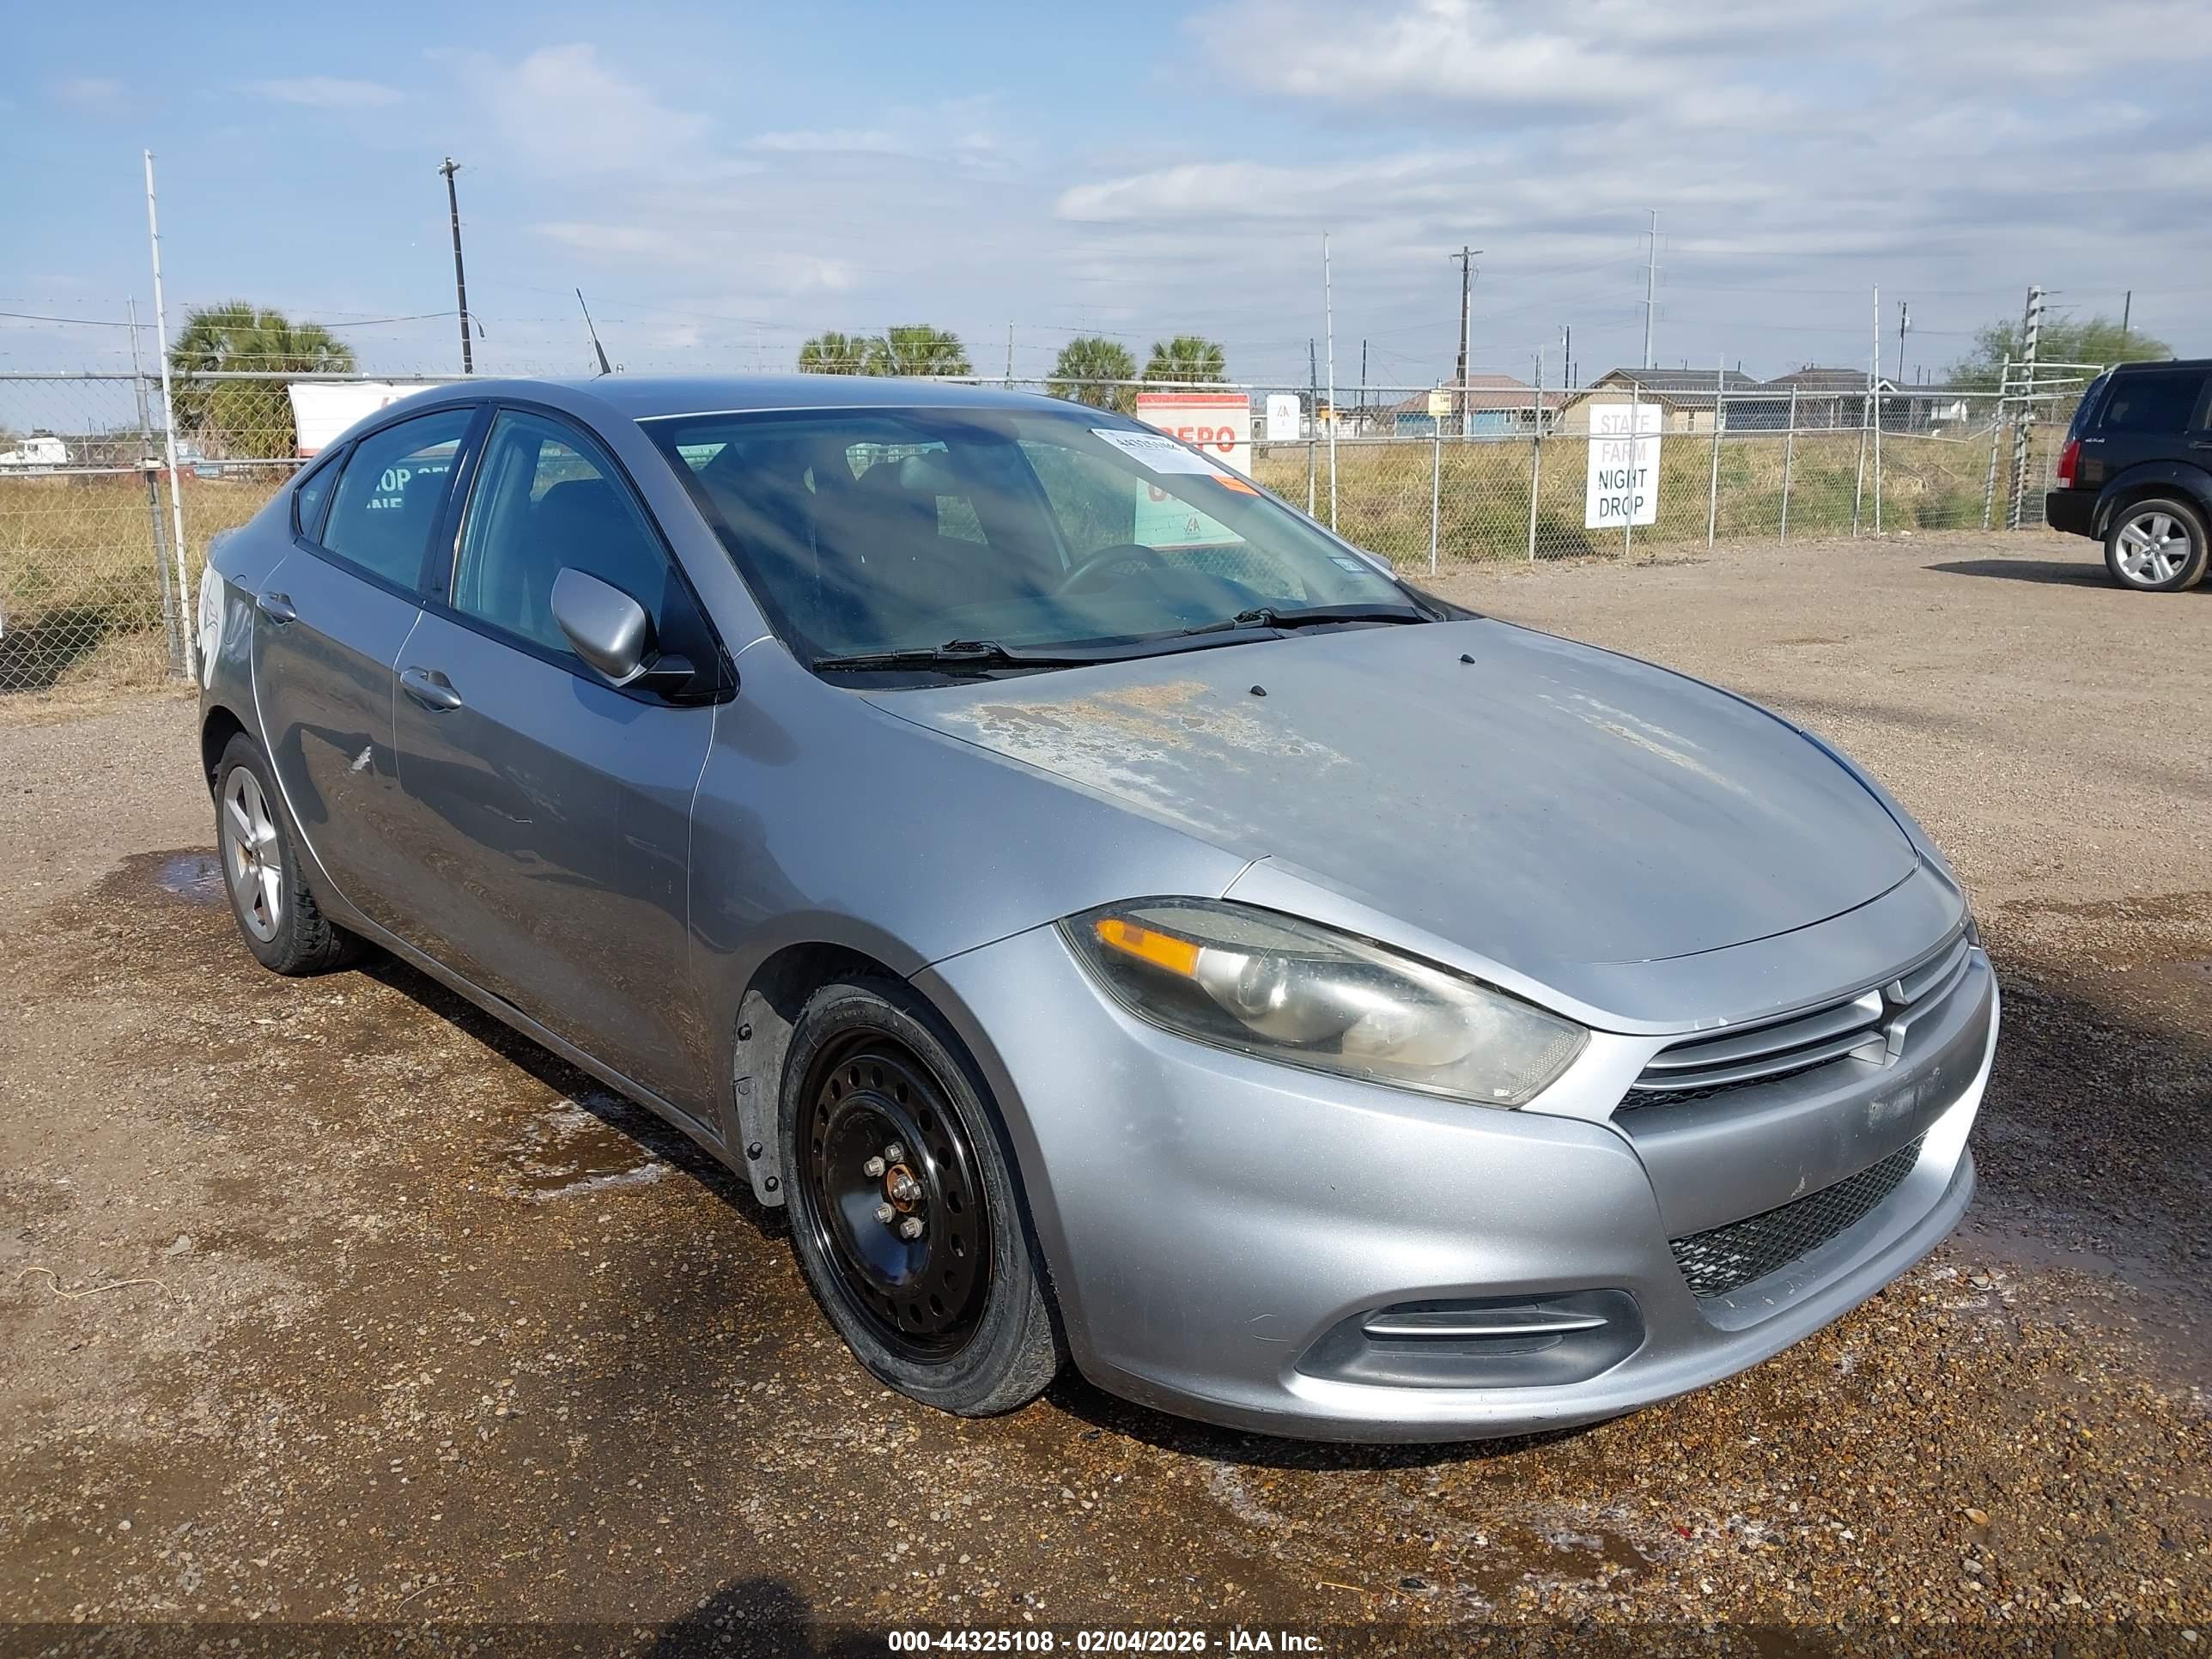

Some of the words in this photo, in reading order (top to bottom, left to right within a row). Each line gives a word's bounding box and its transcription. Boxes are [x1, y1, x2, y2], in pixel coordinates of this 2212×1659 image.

[1601, 415, 1650, 434] STAE
[1601, 441, 1647, 463] FARM
[375, 468, 411, 492] OP
[1599, 468, 1648, 489] NIGHT
[1599, 495, 1644, 518] DROP
